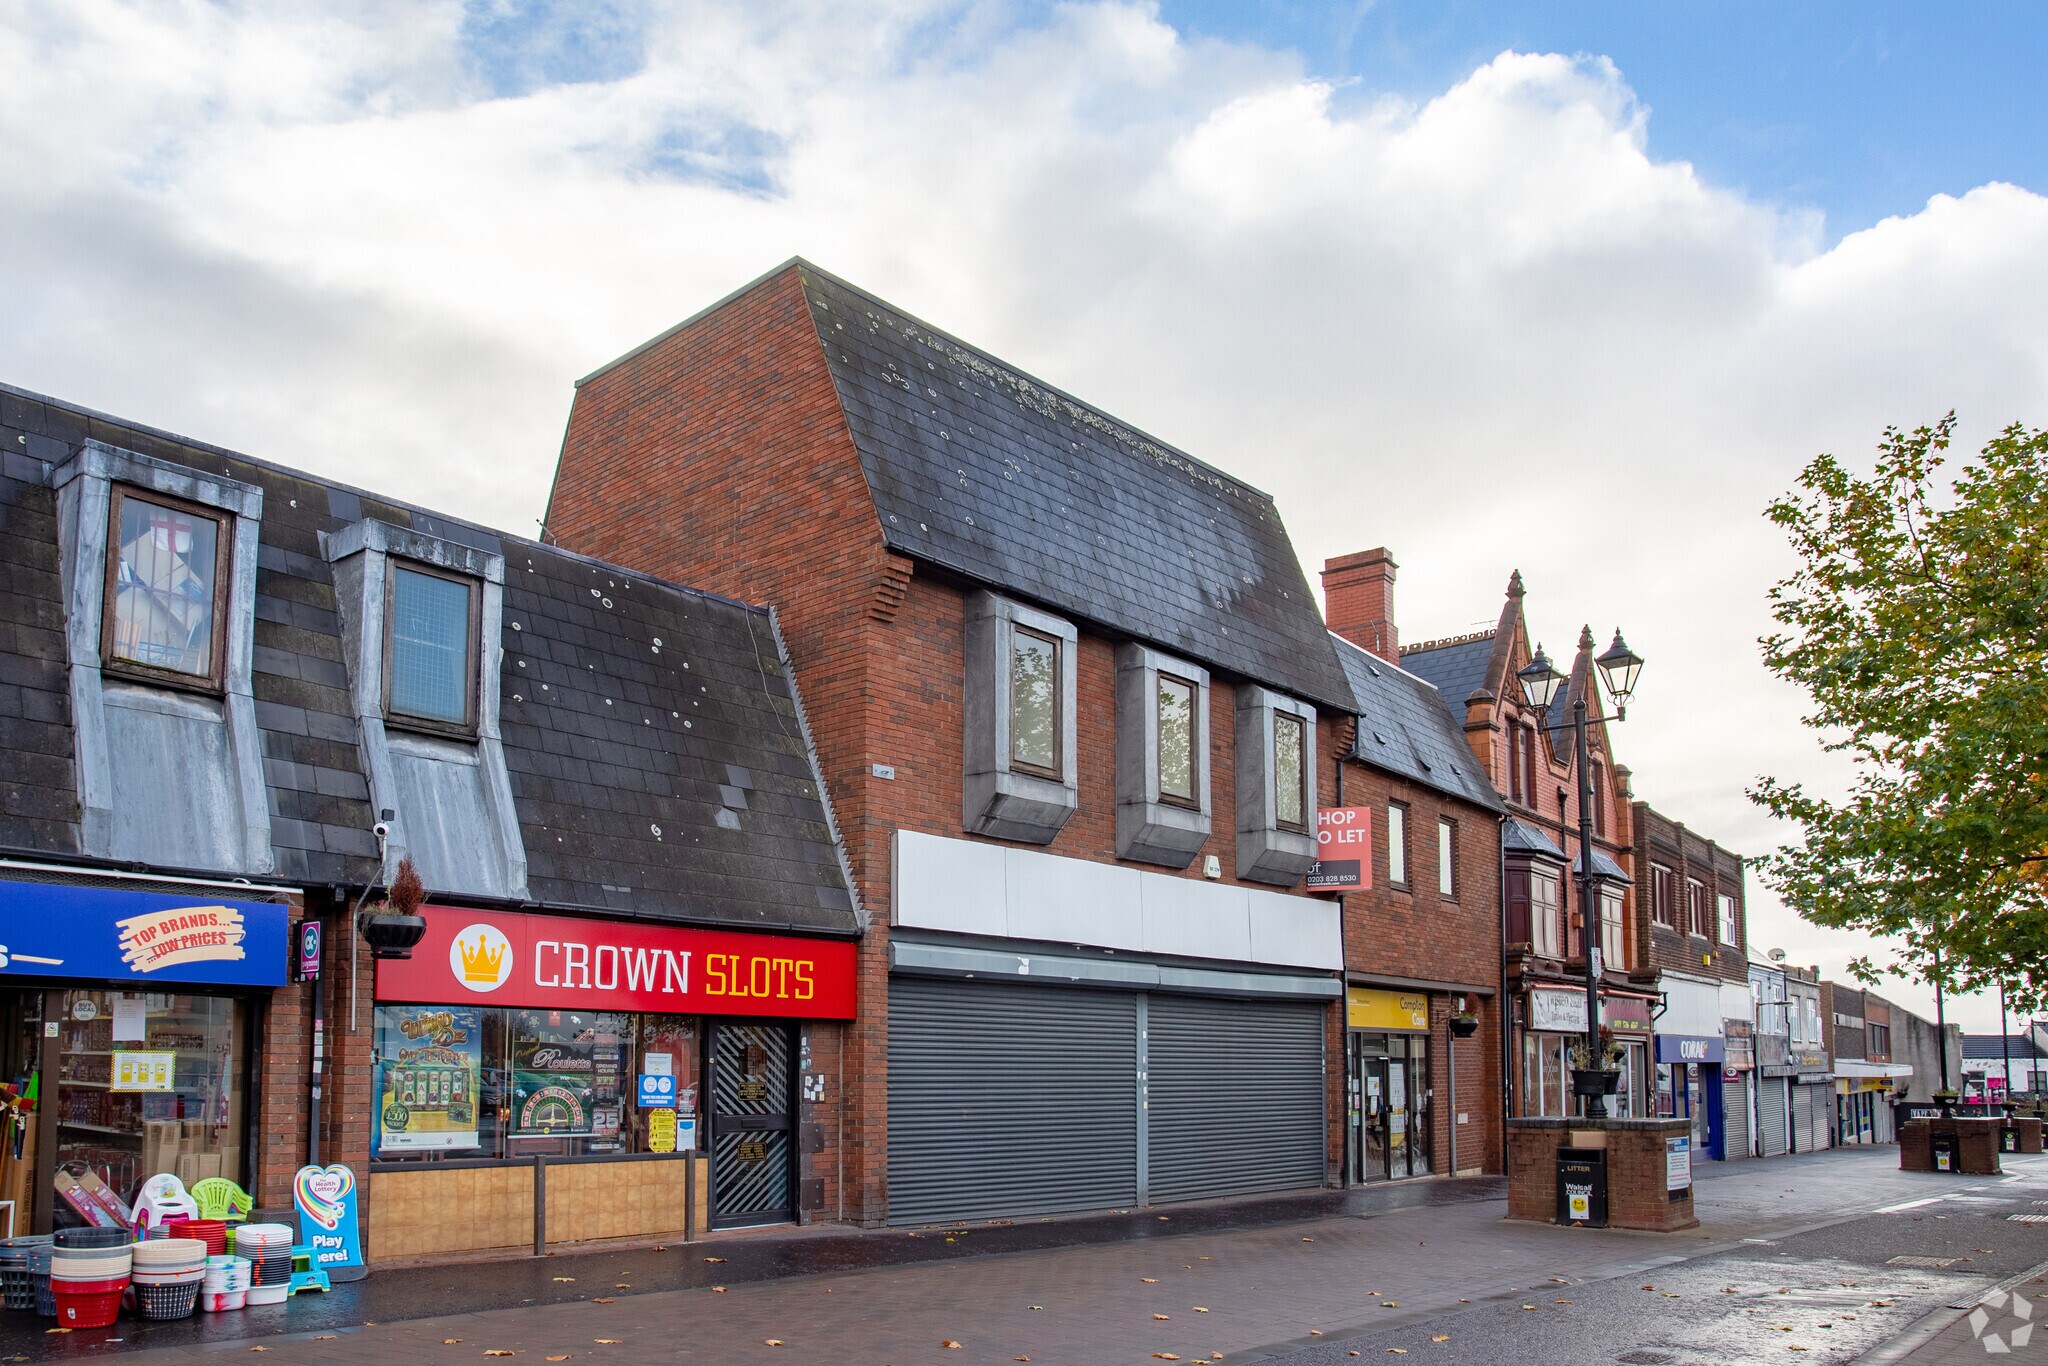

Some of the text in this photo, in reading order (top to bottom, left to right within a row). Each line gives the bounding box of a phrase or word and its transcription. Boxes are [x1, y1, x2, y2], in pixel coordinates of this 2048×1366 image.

[1318, 811, 1356, 825] HOP
[1318, 829, 1365, 844] O LET
[131, 912, 230, 947] TOP BRANDS...
[181, 931, 227, 951] PRICES
[534, 940, 814, 1000] CROWN SLOTS
[1400, 997, 1425, 1017] Compton
[1411, 1011, 1426, 1026] Care
[532, 1048, 592, 1069] Roulette
[1680, 1040, 1705, 1059] CORAL
[593, 1112, 619, 1129] 25
[1566, 1183, 1593, 1191] Walsall
[312, 1235, 343, 1249] Play
